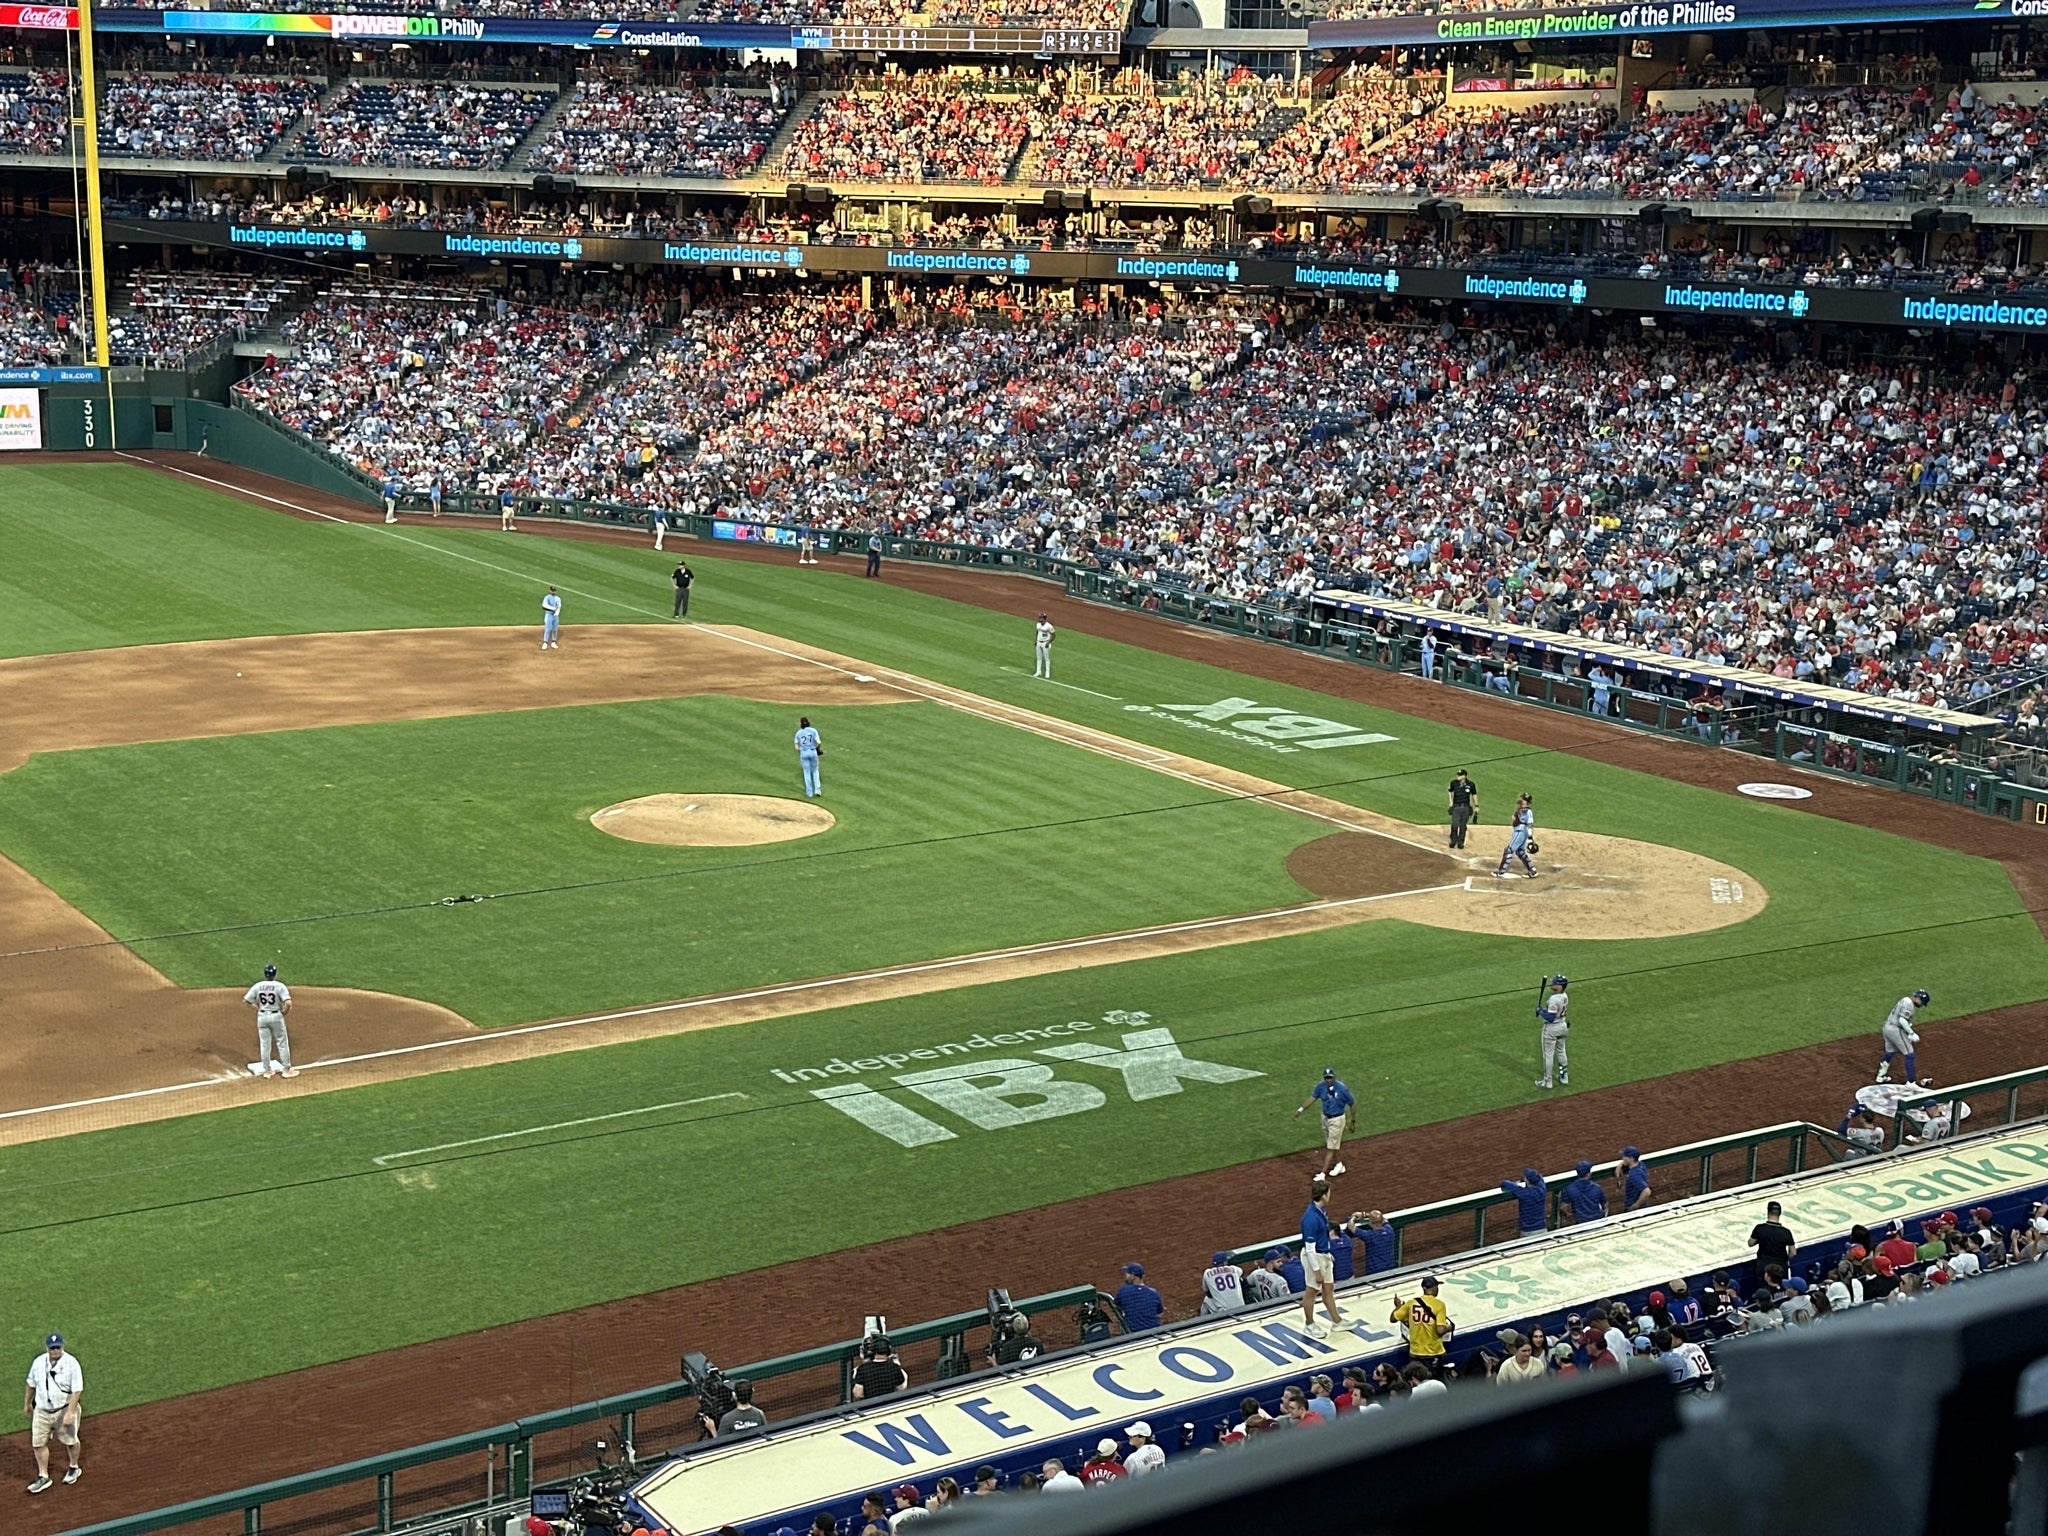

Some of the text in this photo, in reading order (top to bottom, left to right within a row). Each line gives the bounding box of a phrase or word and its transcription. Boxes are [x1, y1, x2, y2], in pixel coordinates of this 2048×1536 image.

[441, 17, 485, 39] Philly
[1437, 2, 1736, 39] Clean Energy Provider of the Phillies
[621, 30, 702, 46] Constellation
[801, 28, 822, 37] NYM
[863, 29, 869, 38] 0
[911, 30, 917, 38] 0
[1060, 33, 1066, 41] 3
[1107, 33, 1113, 41] 2
[804, 38, 820, 48] PHI
[863, 40, 869, 48] 0
[1060, 43, 1066, 51] 3
[1108, 43, 1113, 52] 1
[1046, 35, 1102, 48] R H E
[230, 226, 345, 249] Independence
[446, 235, 561, 257] Independence
[664, 243, 781, 266] Independence
[887, 250, 1007, 273] Independence
[1117, 257, 1224, 278] Independence
[1295, 264, 1382, 287] Independence
[1465, 274, 1566, 298] Independence
[1664, 284, 1785, 311] Independence
[1903, 296, 2047, 326] Independence
[60, 371, 93, 380] ibx.com
[83, 399, 94, 448] 330
[1150, 711, 1301, 754] Independence
[1156, 697, 1400, 749] IBX
[801, 734, 813, 745] 27
[259, 992, 276, 1006] 63
[770, 1019, 1096, 1084] Independence
[808, 1027, 1268, 1149] IBX
[1824, 1155, 2033, 1213] Bank
[1214, 1273, 1236, 1292] 80
[1683, 1303, 1699, 1322] 17
[1673, 1368, 1684, 1381] 7
[1690, 1354, 1710, 1374] 12
[841, 1305, 1396, 1466] WELCOME
[1088, 1468, 1117, 1482] HARPER
